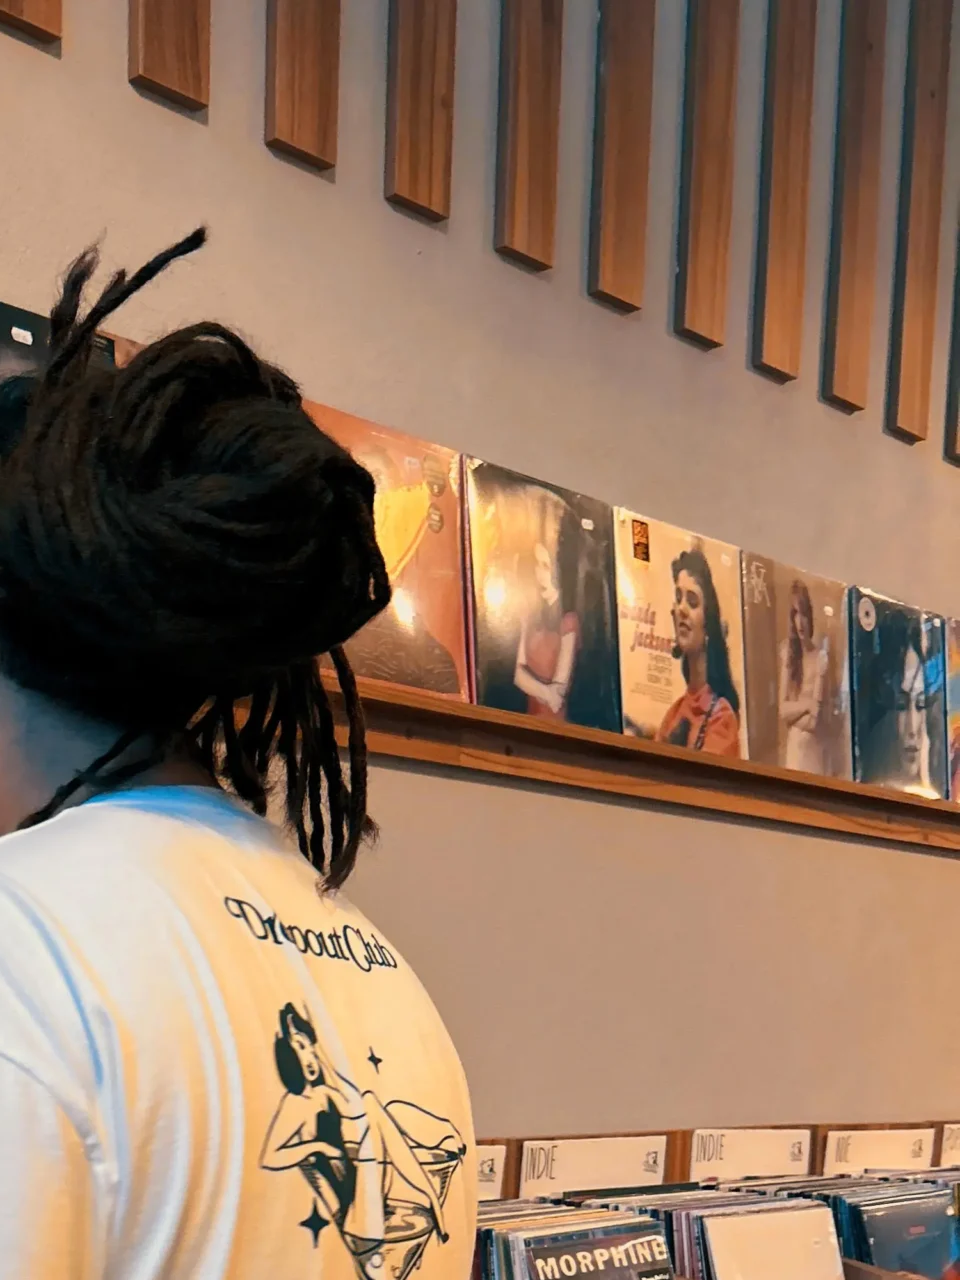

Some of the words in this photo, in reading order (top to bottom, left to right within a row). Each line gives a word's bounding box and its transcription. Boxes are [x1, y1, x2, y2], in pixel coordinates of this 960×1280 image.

[342, 924, 398, 972] Club
[525, 1145, 558, 1182] INDIE
[695, 1133, 725, 1162] INDIE
[535, 1237, 668, 1280] MORPHINE
